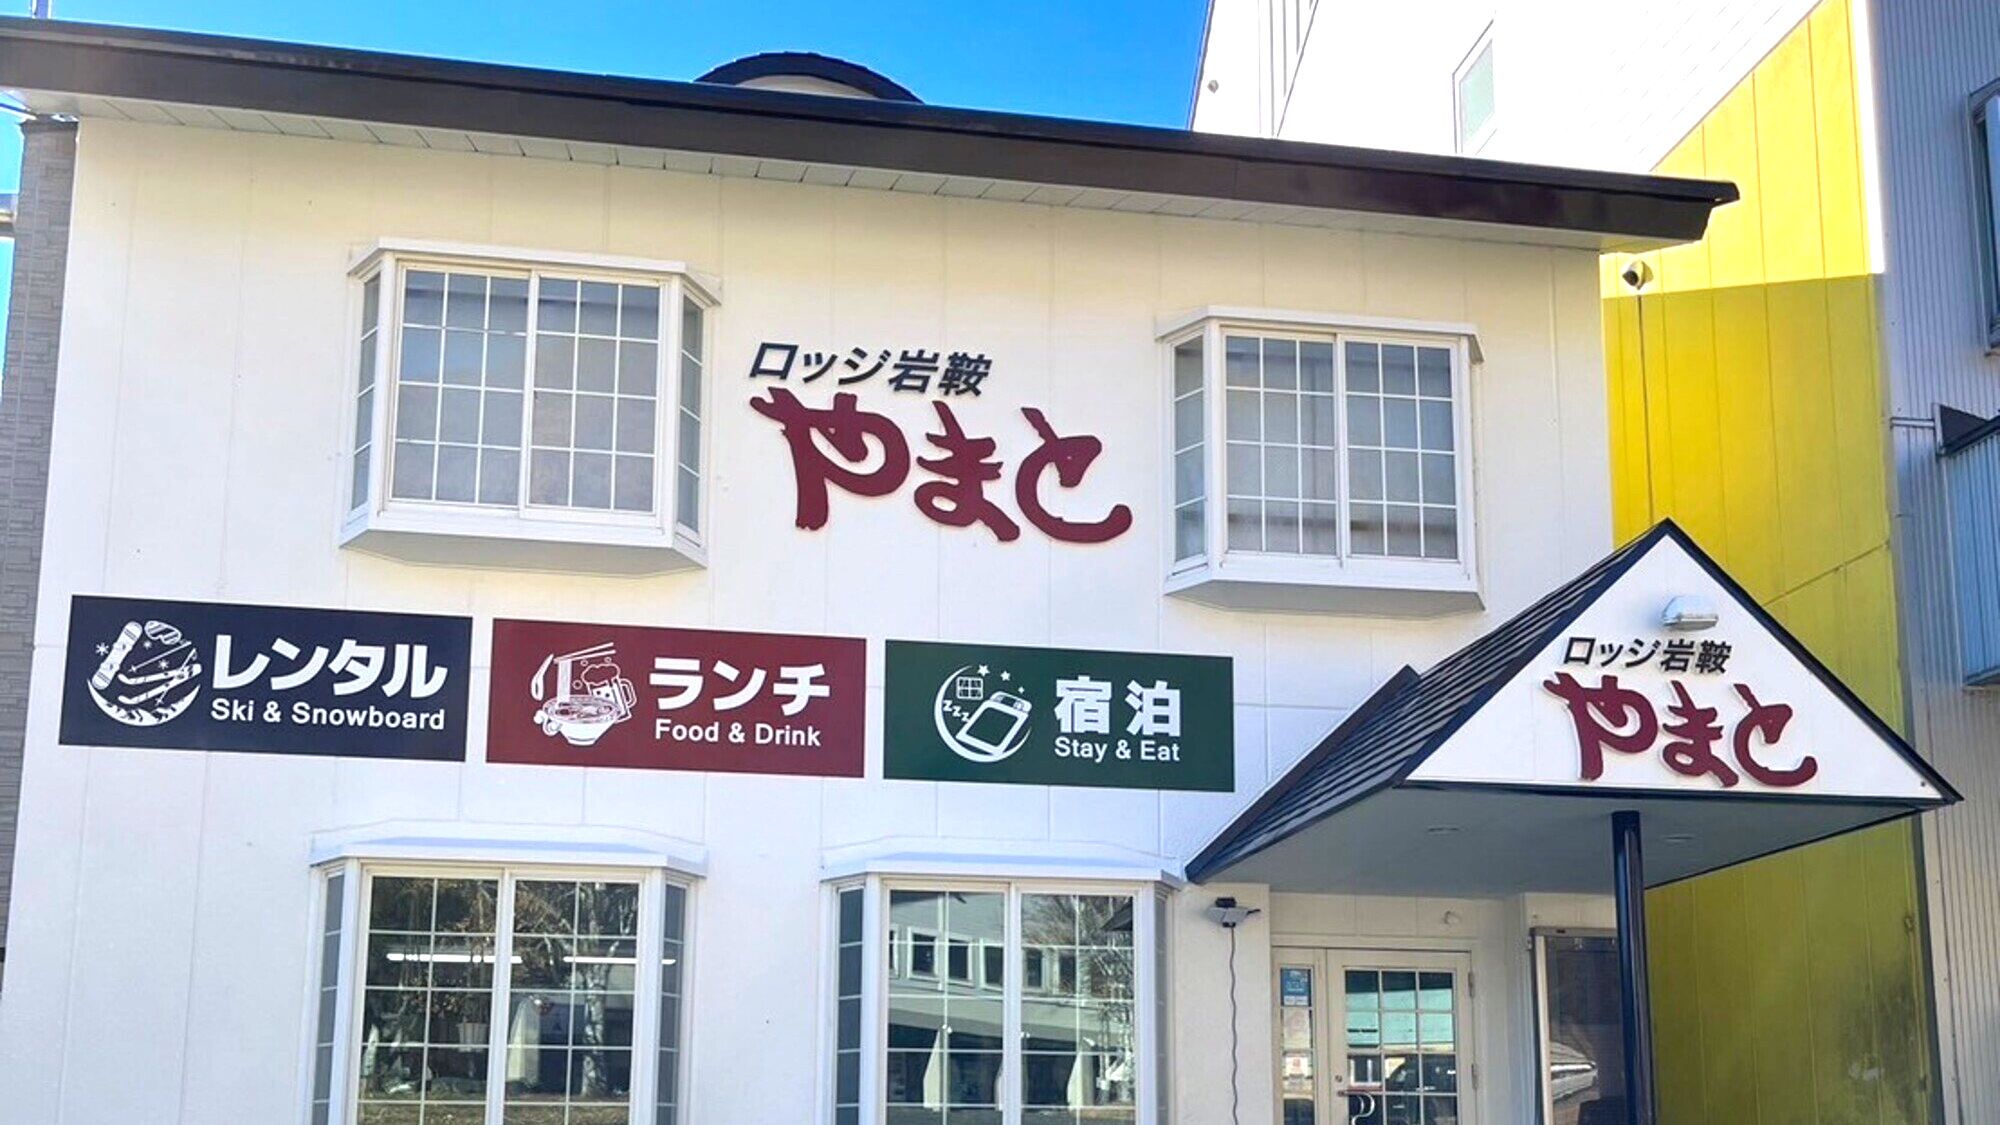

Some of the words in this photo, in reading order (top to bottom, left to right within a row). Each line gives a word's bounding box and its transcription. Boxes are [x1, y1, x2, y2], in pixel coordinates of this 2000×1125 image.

[749, 341, 992, 397] ロッジ岩鞍
[749, 386, 1133, 544] やまと
[212, 634, 448, 698] レンタル
[1563, 636, 1733, 674] ロッジ岩鞍
[210, 697, 254, 722] Ski
[263, 703, 282, 723] &
[292, 703, 445, 731] Snowboard
[649, 657, 829, 716] ランチ
[1054, 675, 1181, 736] 宿泊
[655, 718, 719, 743] Food
[728, 723, 746, 744] &
[755, 723, 820, 747] Drink
[1054, 737, 1108, 763] Stay
[1115, 740, 1132, 760] &
[1141, 742, 1180, 762] Eat
[1543, 671, 1818, 787] やまと
